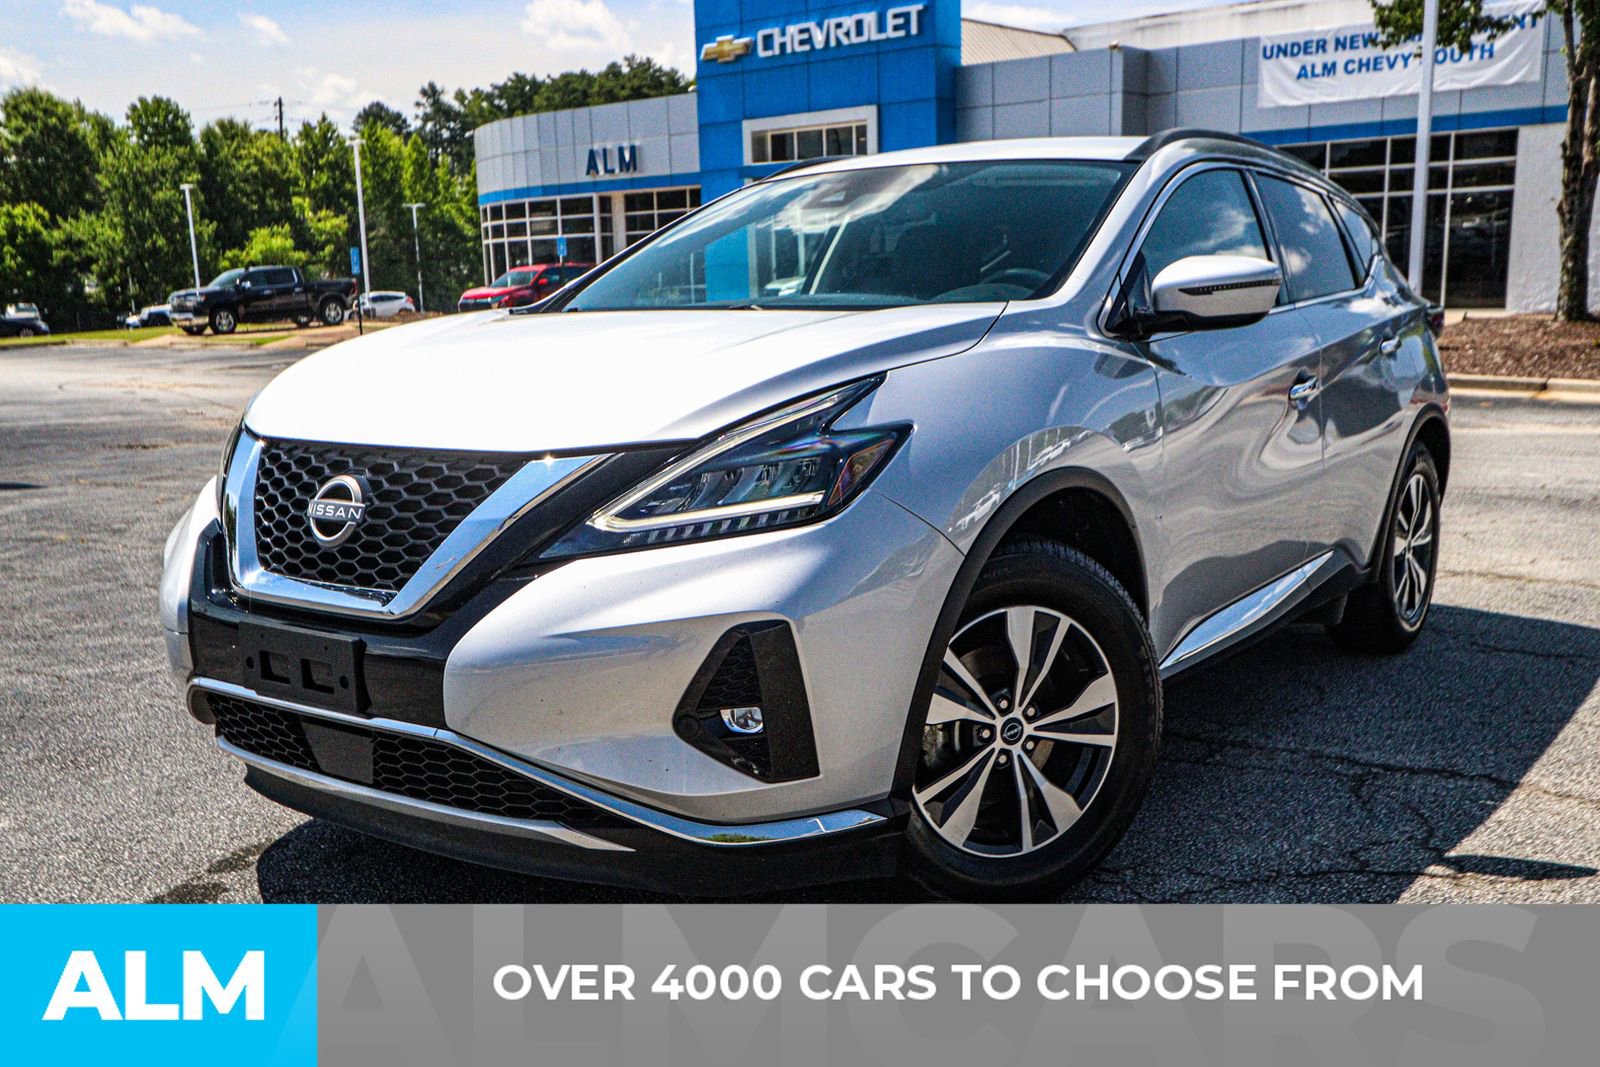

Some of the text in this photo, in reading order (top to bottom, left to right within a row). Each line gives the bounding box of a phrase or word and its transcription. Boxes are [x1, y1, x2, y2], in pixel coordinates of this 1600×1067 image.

[757, 4, 924, 58] CHEVROLET
[1262, 31, 1379, 60] UNDER NEW
[1296, 43, 1495, 80] ALM CHEVY OUTH
[585, 145, 638, 176] ALM
[308, 503, 362, 520] NISSAN
